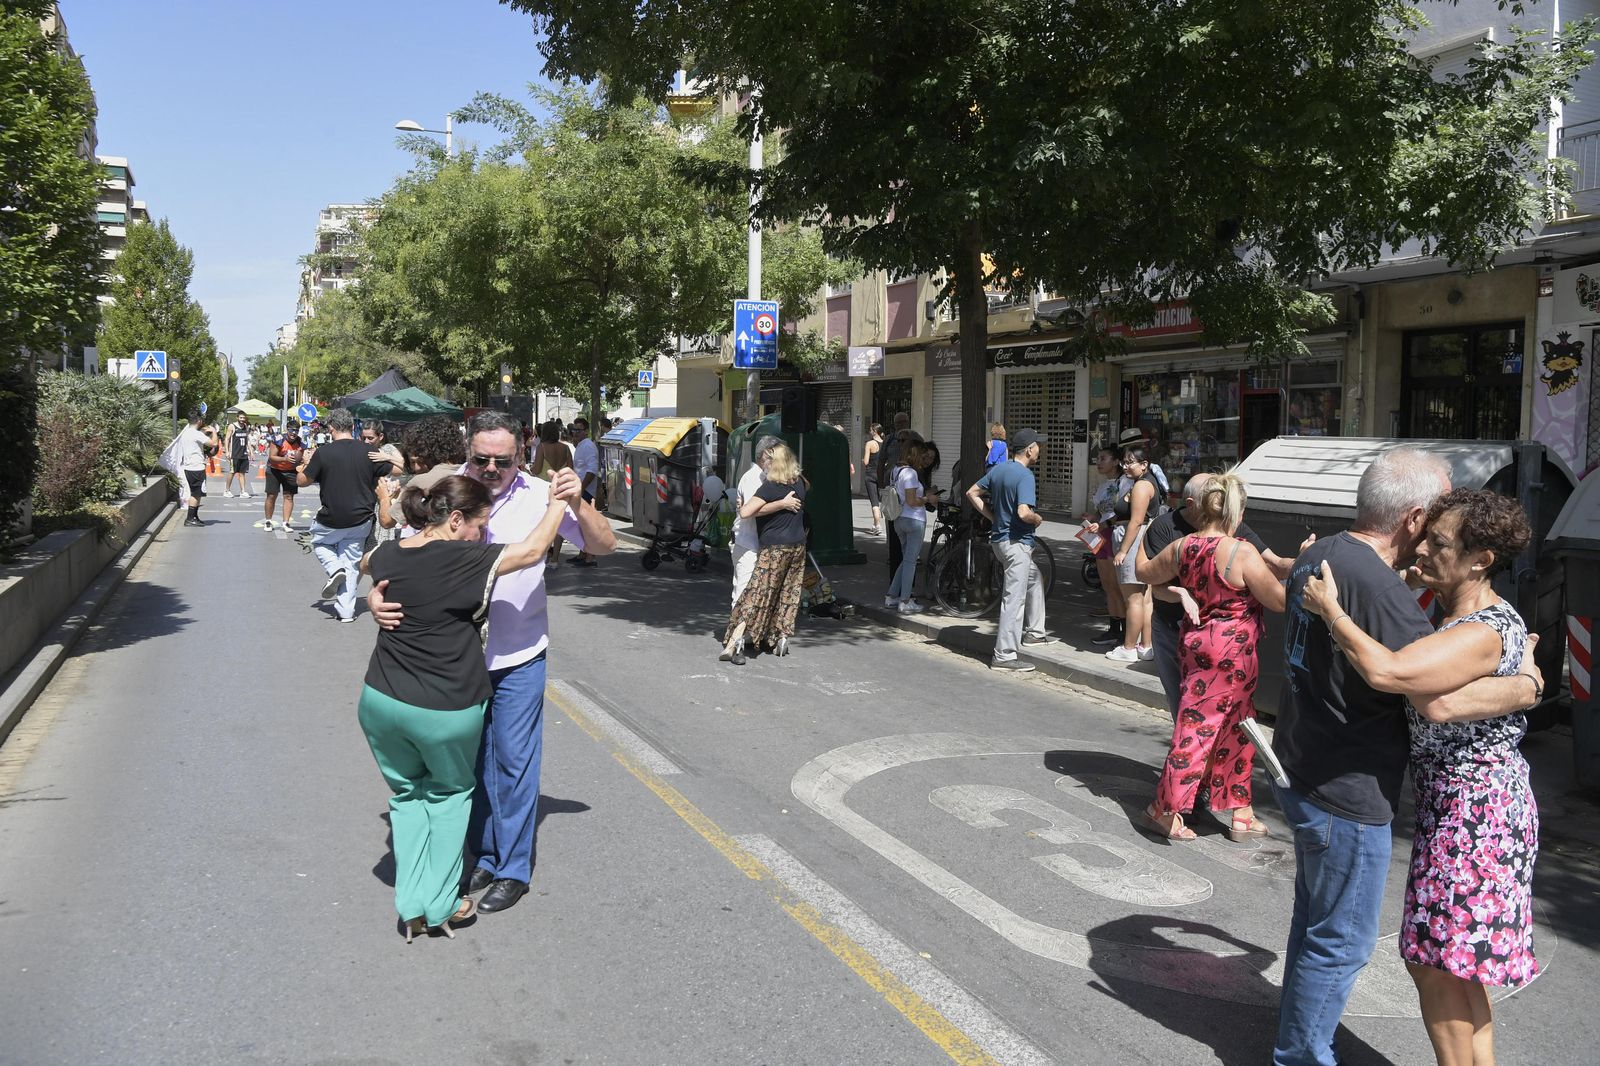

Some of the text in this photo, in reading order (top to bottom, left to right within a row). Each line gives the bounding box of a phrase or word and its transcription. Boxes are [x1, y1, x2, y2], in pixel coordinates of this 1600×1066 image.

[737, 302, 776, 312] ATENCIÓN
[759, 320, 771, 329] 30
[1464, 374, 1476, 383] 50
